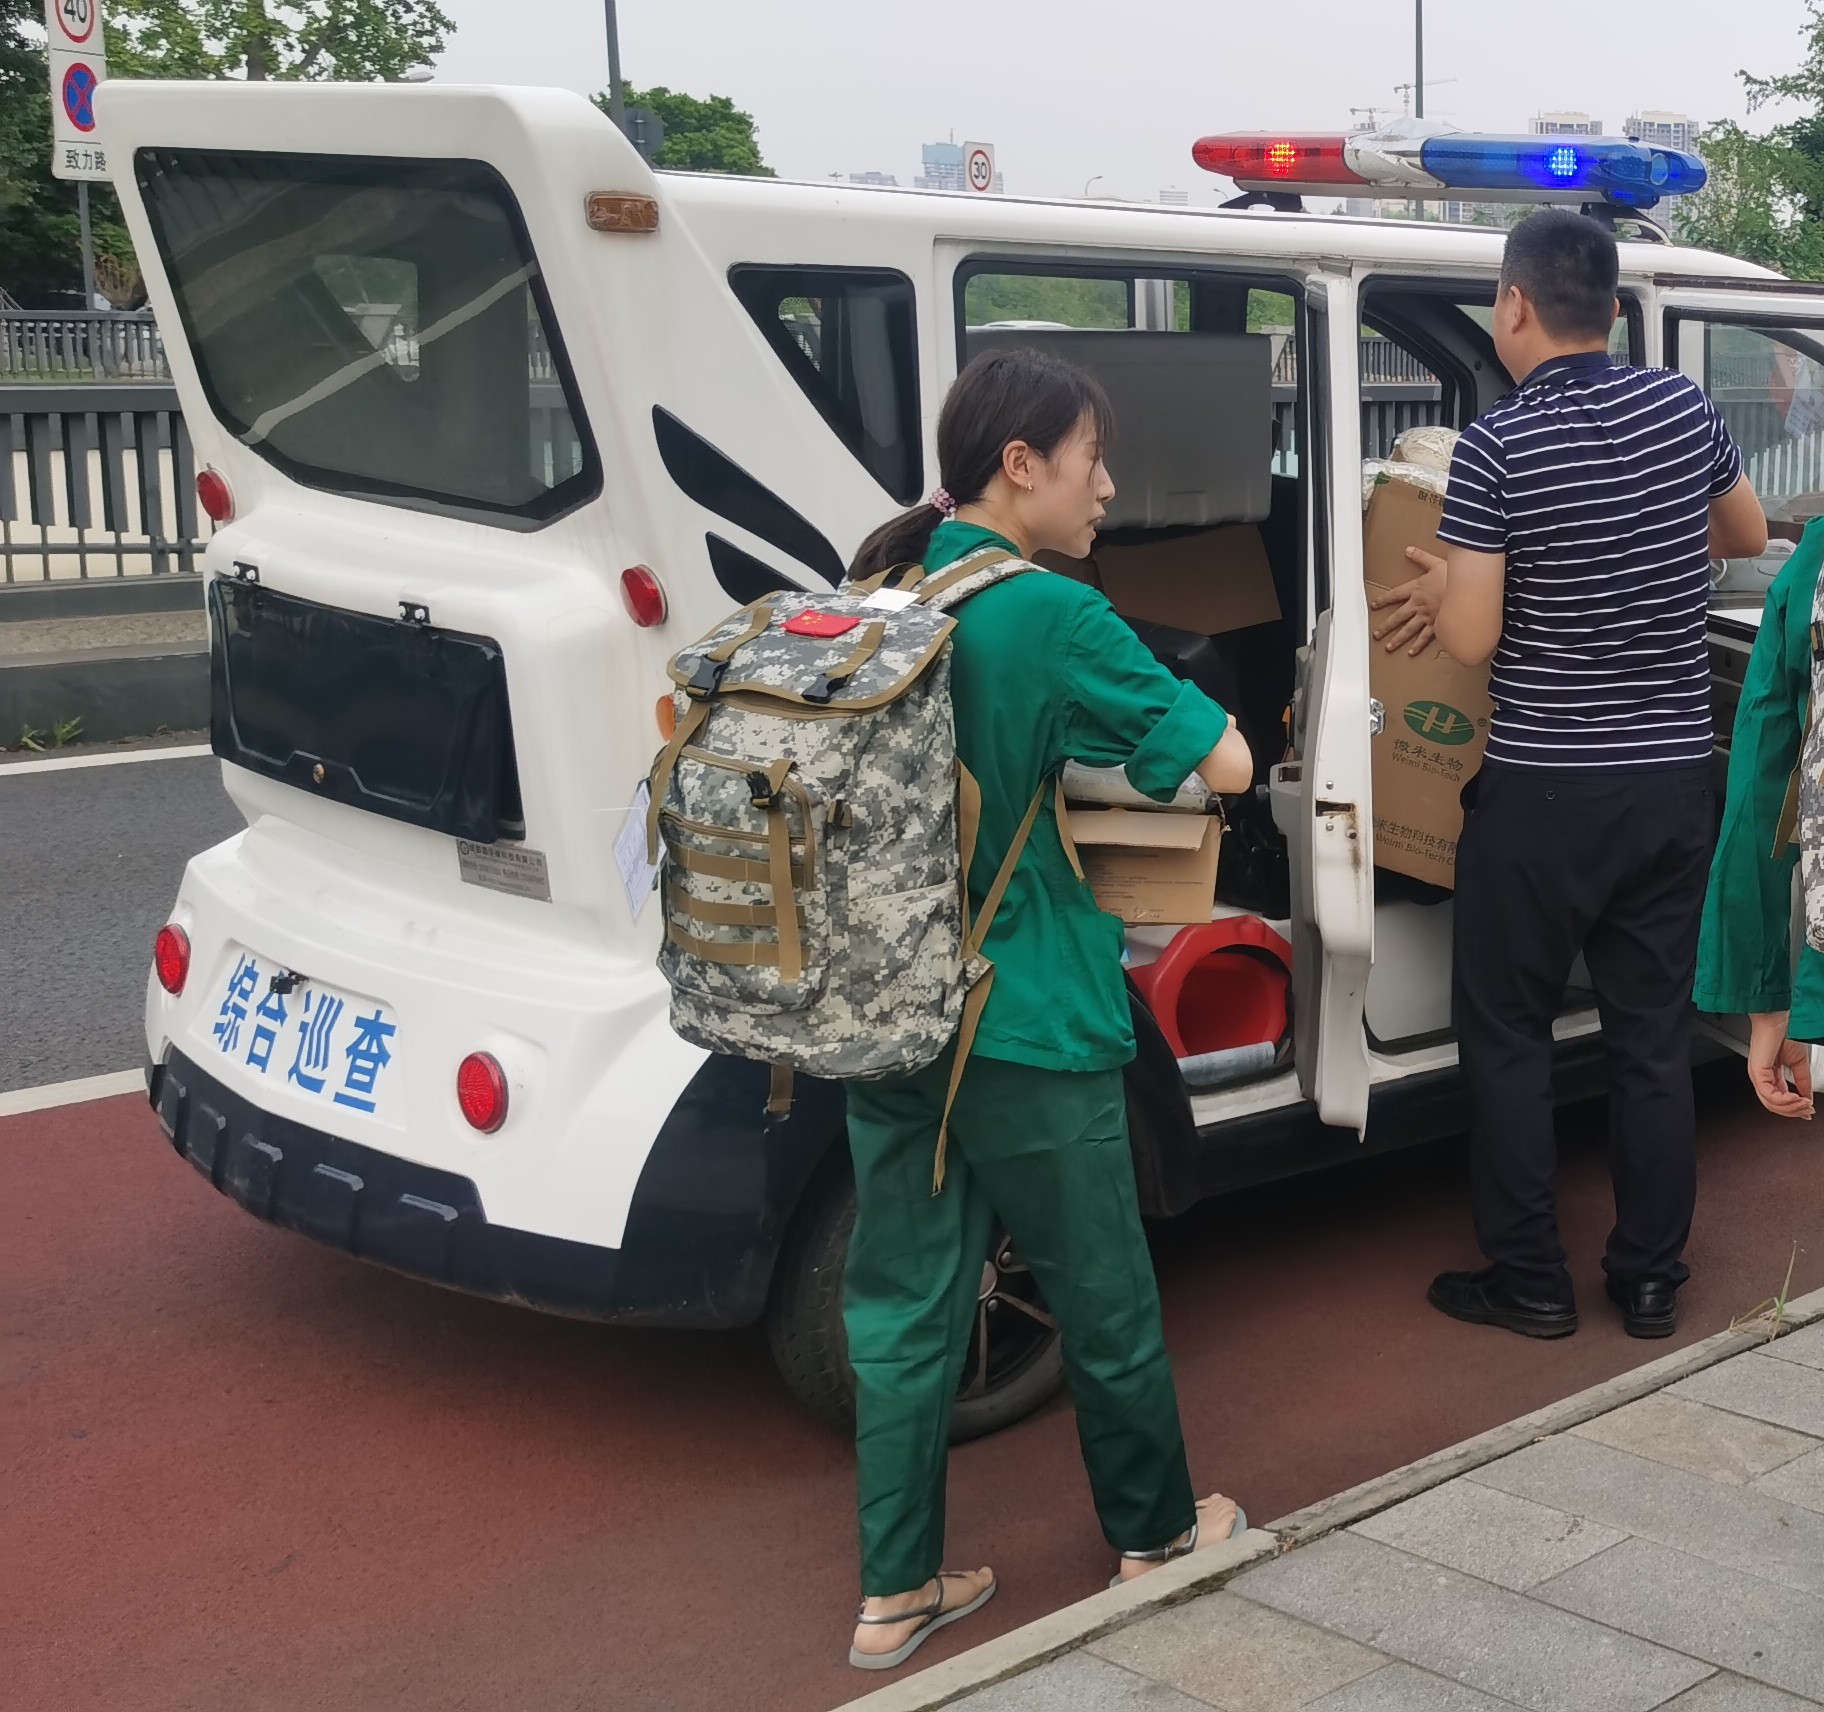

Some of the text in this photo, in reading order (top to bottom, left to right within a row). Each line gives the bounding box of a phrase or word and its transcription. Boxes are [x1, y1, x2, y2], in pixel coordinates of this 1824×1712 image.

[64, 0, 87, 23] 40
[974, 161, 987, 179] 30
[213, 953, 397, 1113] 综合巡查
